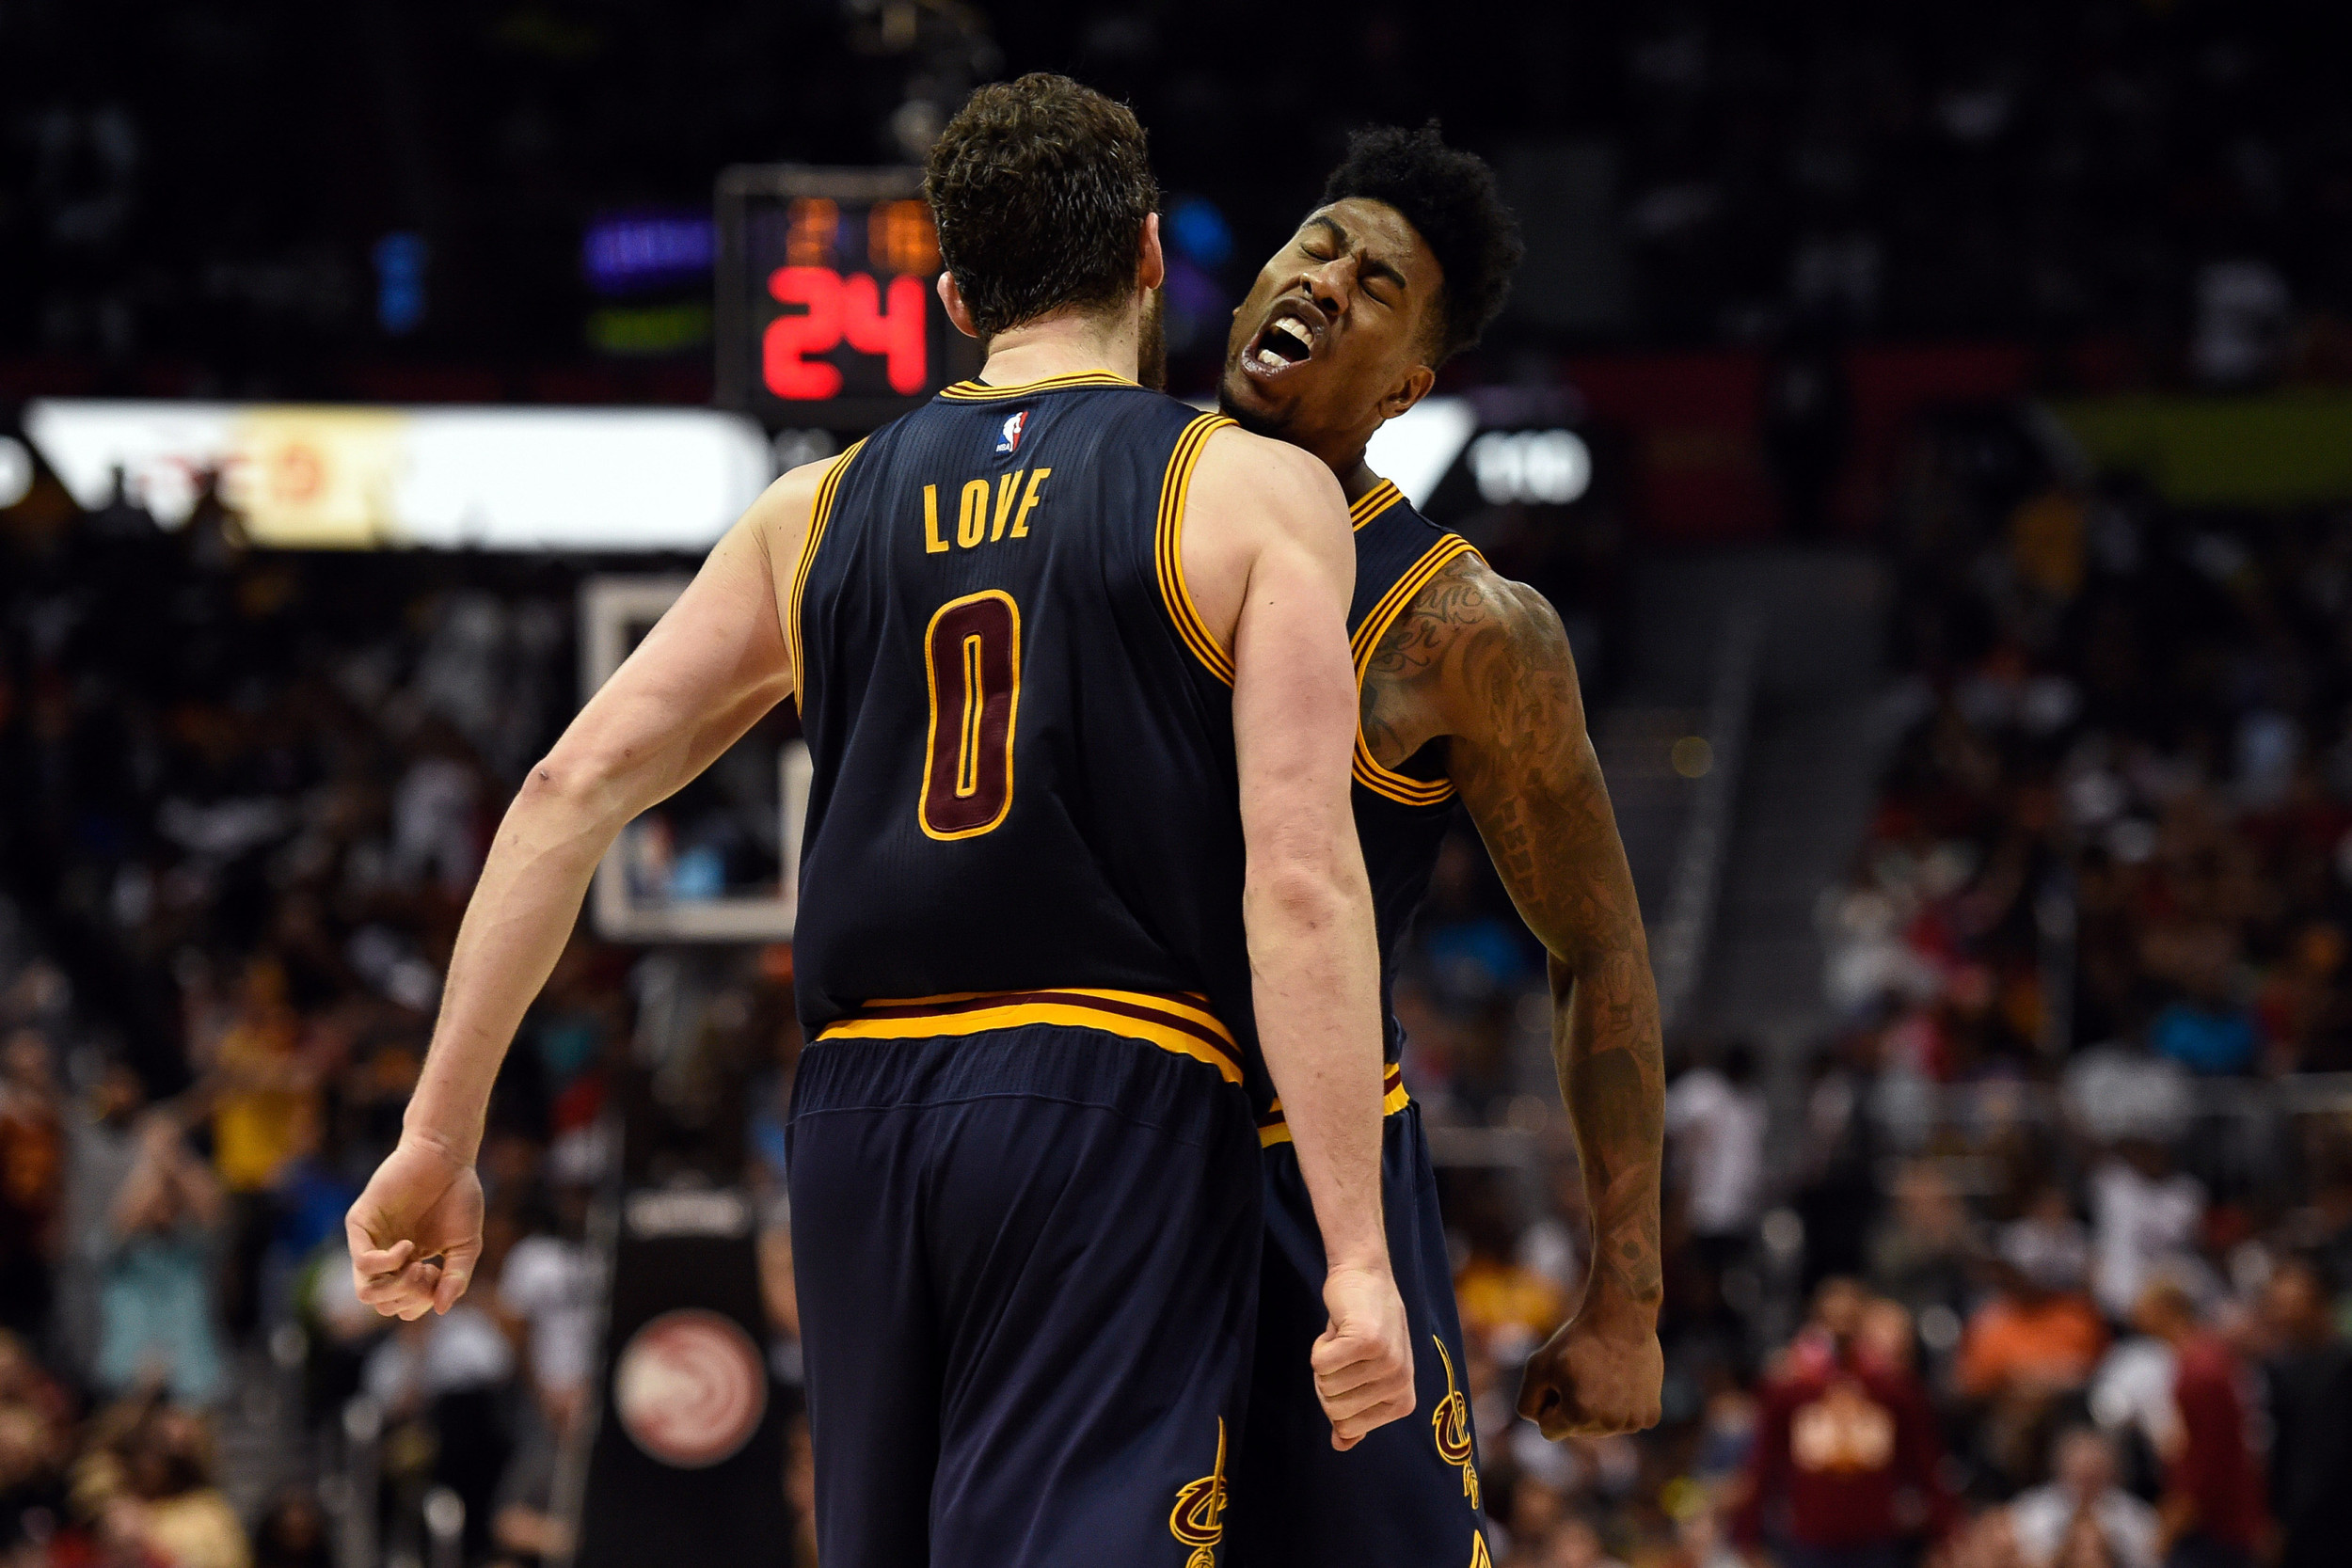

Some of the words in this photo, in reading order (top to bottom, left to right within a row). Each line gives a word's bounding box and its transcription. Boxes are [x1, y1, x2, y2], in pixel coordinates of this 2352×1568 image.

[761, 264, 928, 401] 24
[923, 467, 1052, 554] LOVE
[918, 589, 1021, 841] 0
